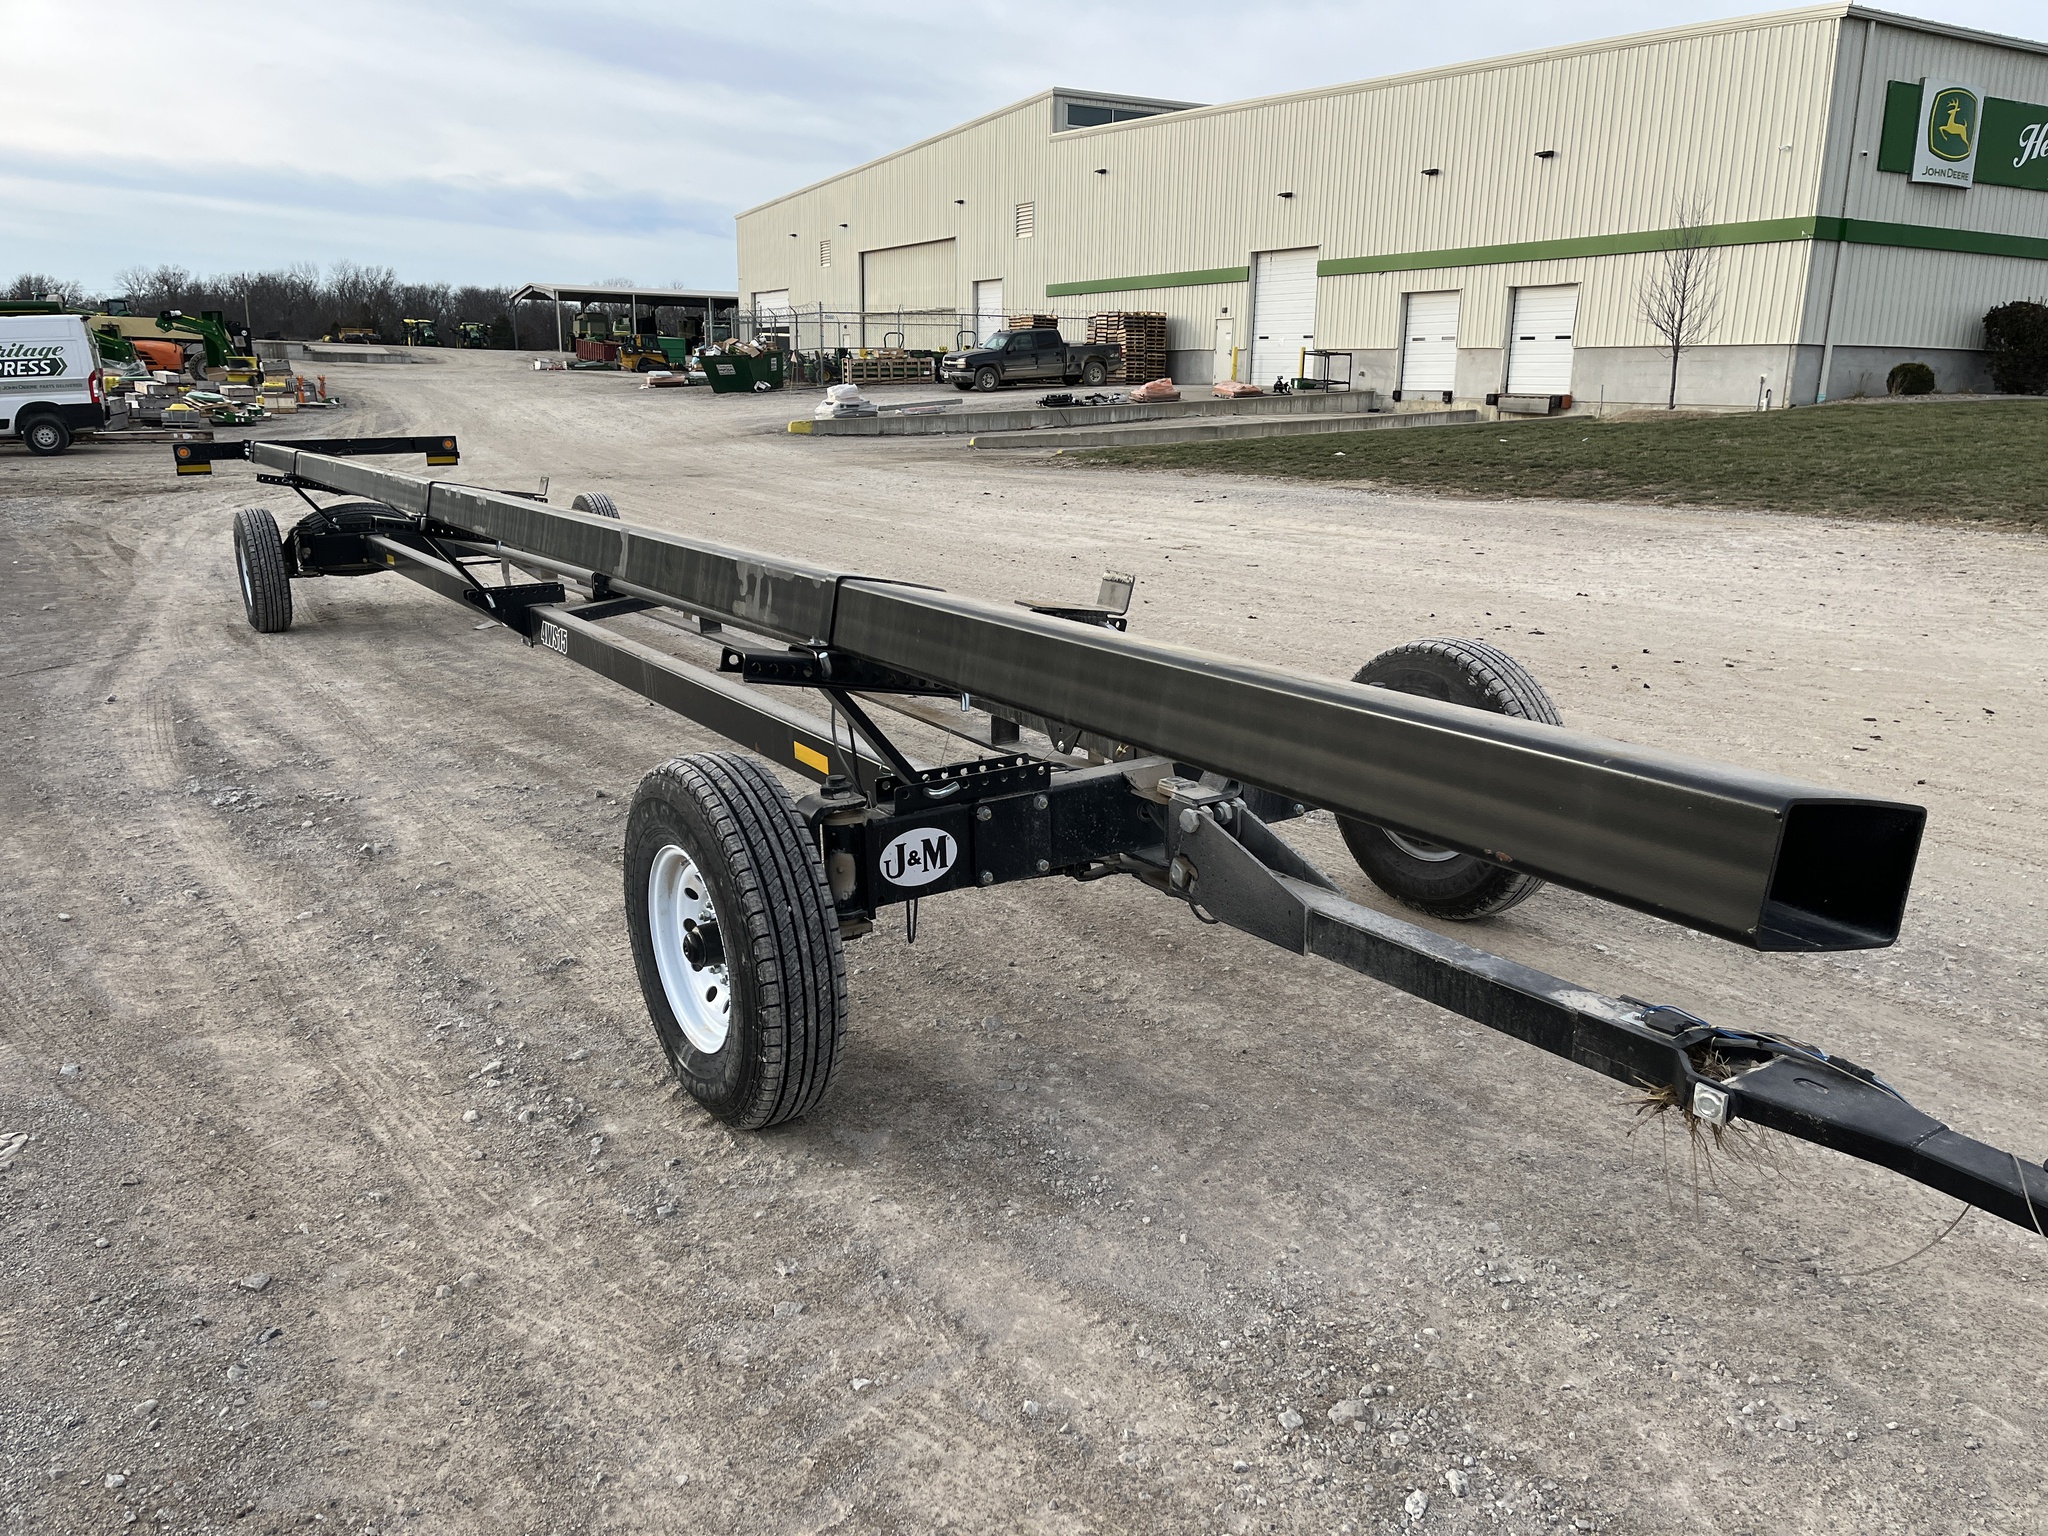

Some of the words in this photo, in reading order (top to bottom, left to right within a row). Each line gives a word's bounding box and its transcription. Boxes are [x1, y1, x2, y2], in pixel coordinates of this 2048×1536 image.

[1921, 165, 1947, 177] JOHN
[1946, 168, 1970, 181] DEERE
[883, 834, 949, 879] J&M
